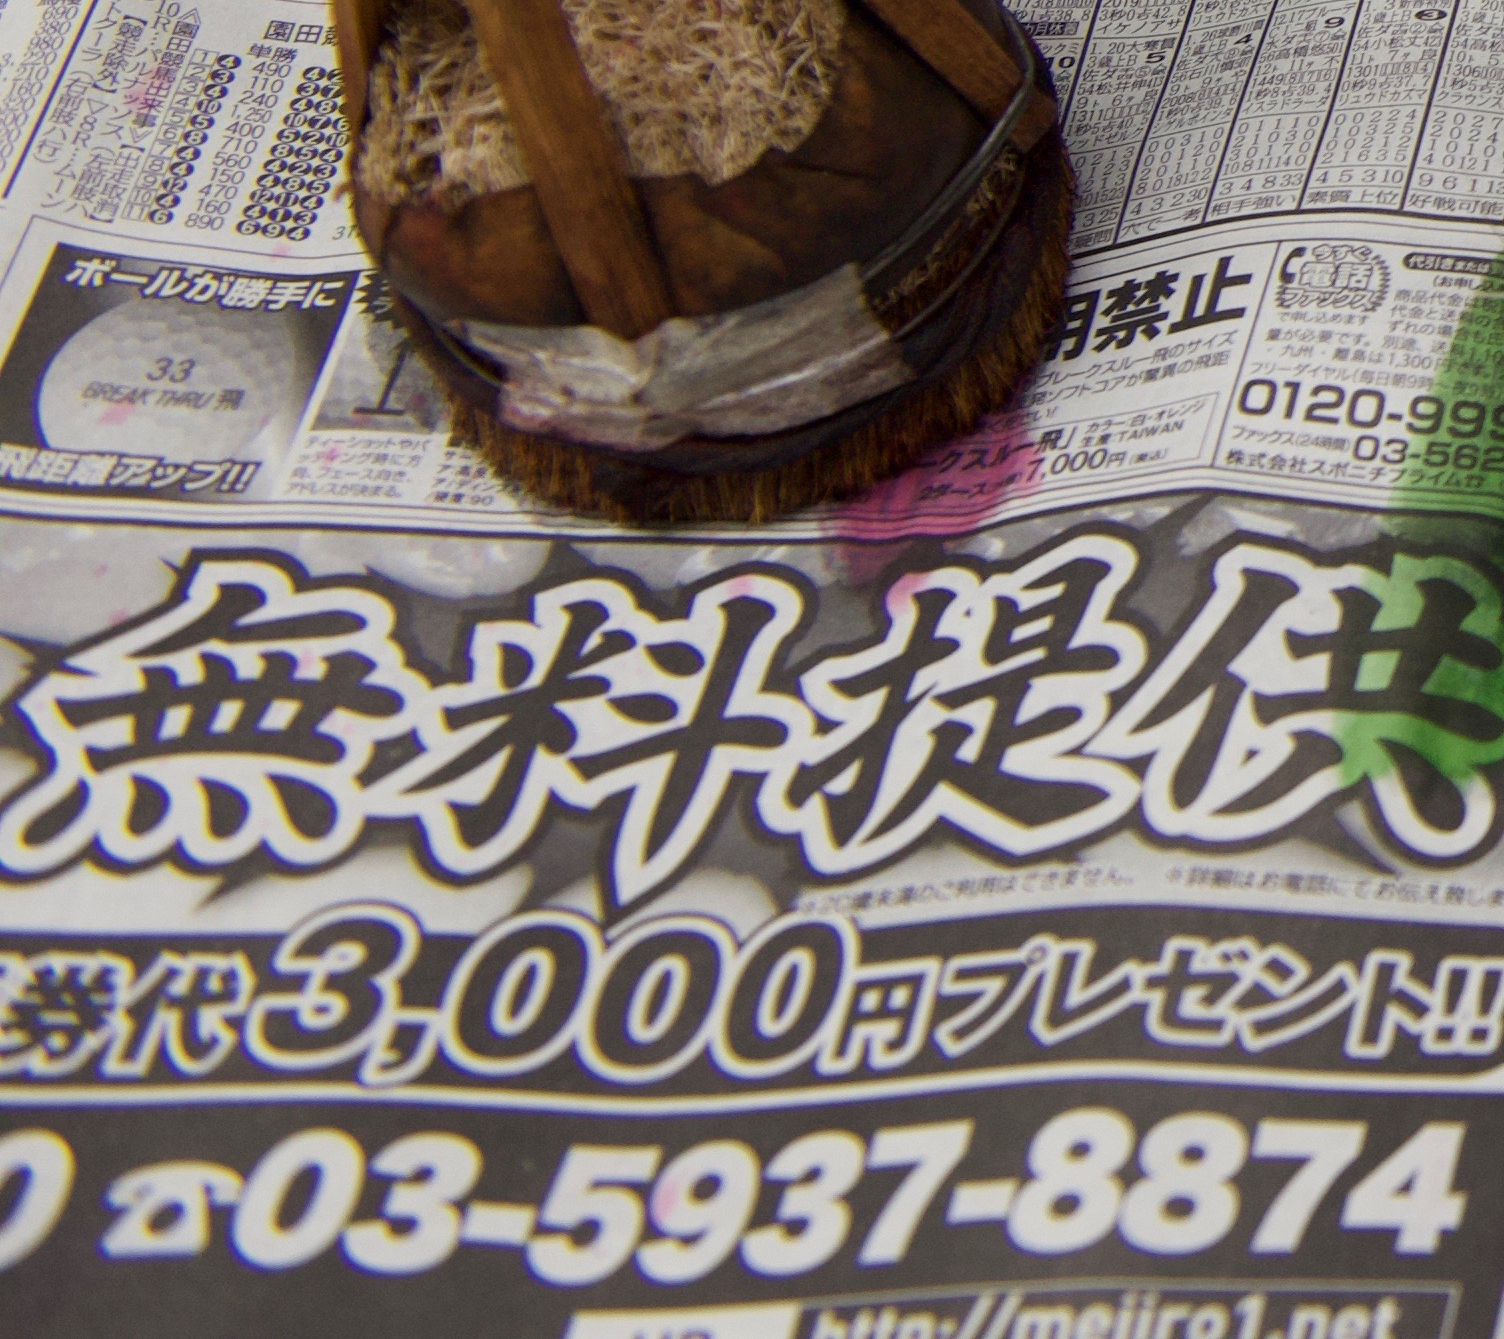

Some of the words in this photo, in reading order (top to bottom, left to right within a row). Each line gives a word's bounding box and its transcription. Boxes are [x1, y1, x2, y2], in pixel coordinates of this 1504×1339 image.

[252, 63, 292, 77] 490
[64, 257, 345, 312] ボールが勝手に
[1299, 261, 1373, 290] 電話
[146, 357, 196, 383] 33
[81, 387, 151, 407] BREAK
[155, 388, 212, 409] THRU
[231, 1107, 1466, 1286] 03-5937-8874
